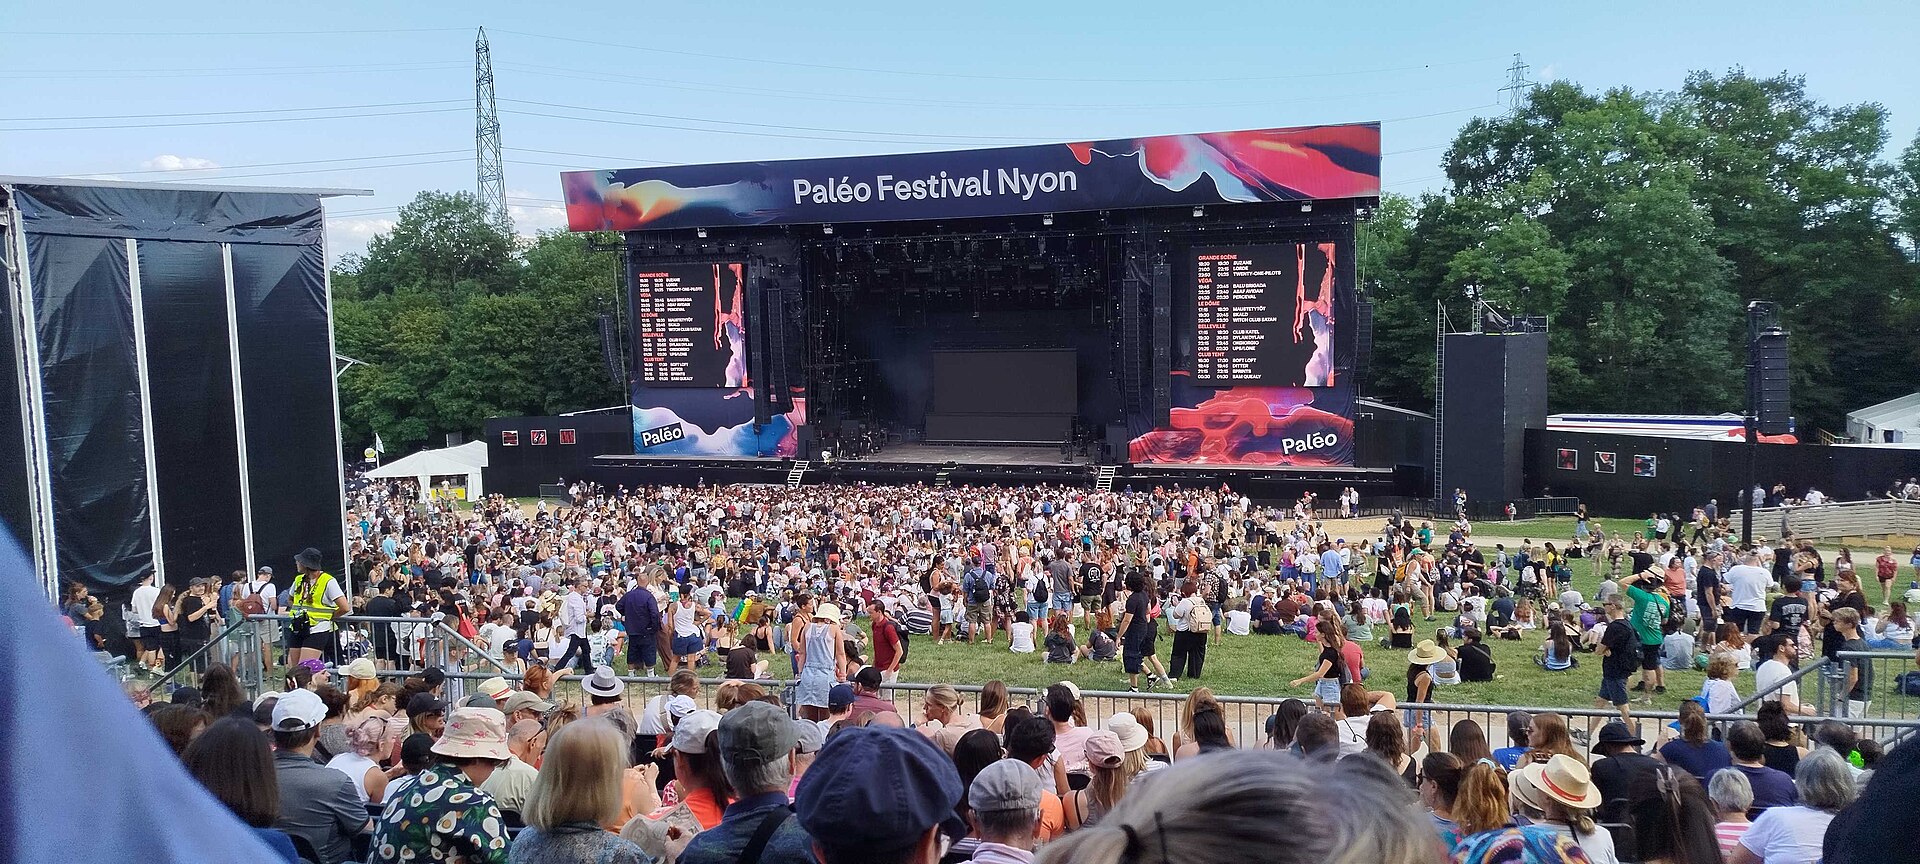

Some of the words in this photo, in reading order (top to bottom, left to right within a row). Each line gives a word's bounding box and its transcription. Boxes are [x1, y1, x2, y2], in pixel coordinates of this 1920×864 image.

[793, 176, 871, 204] Paléo
[877, 170, 992, 201] Festival
[997, 167, 1077, 201] Nyon
[642, 427, 682, 446] Paléo
[1282, 432, 1337, 454] Paléo
